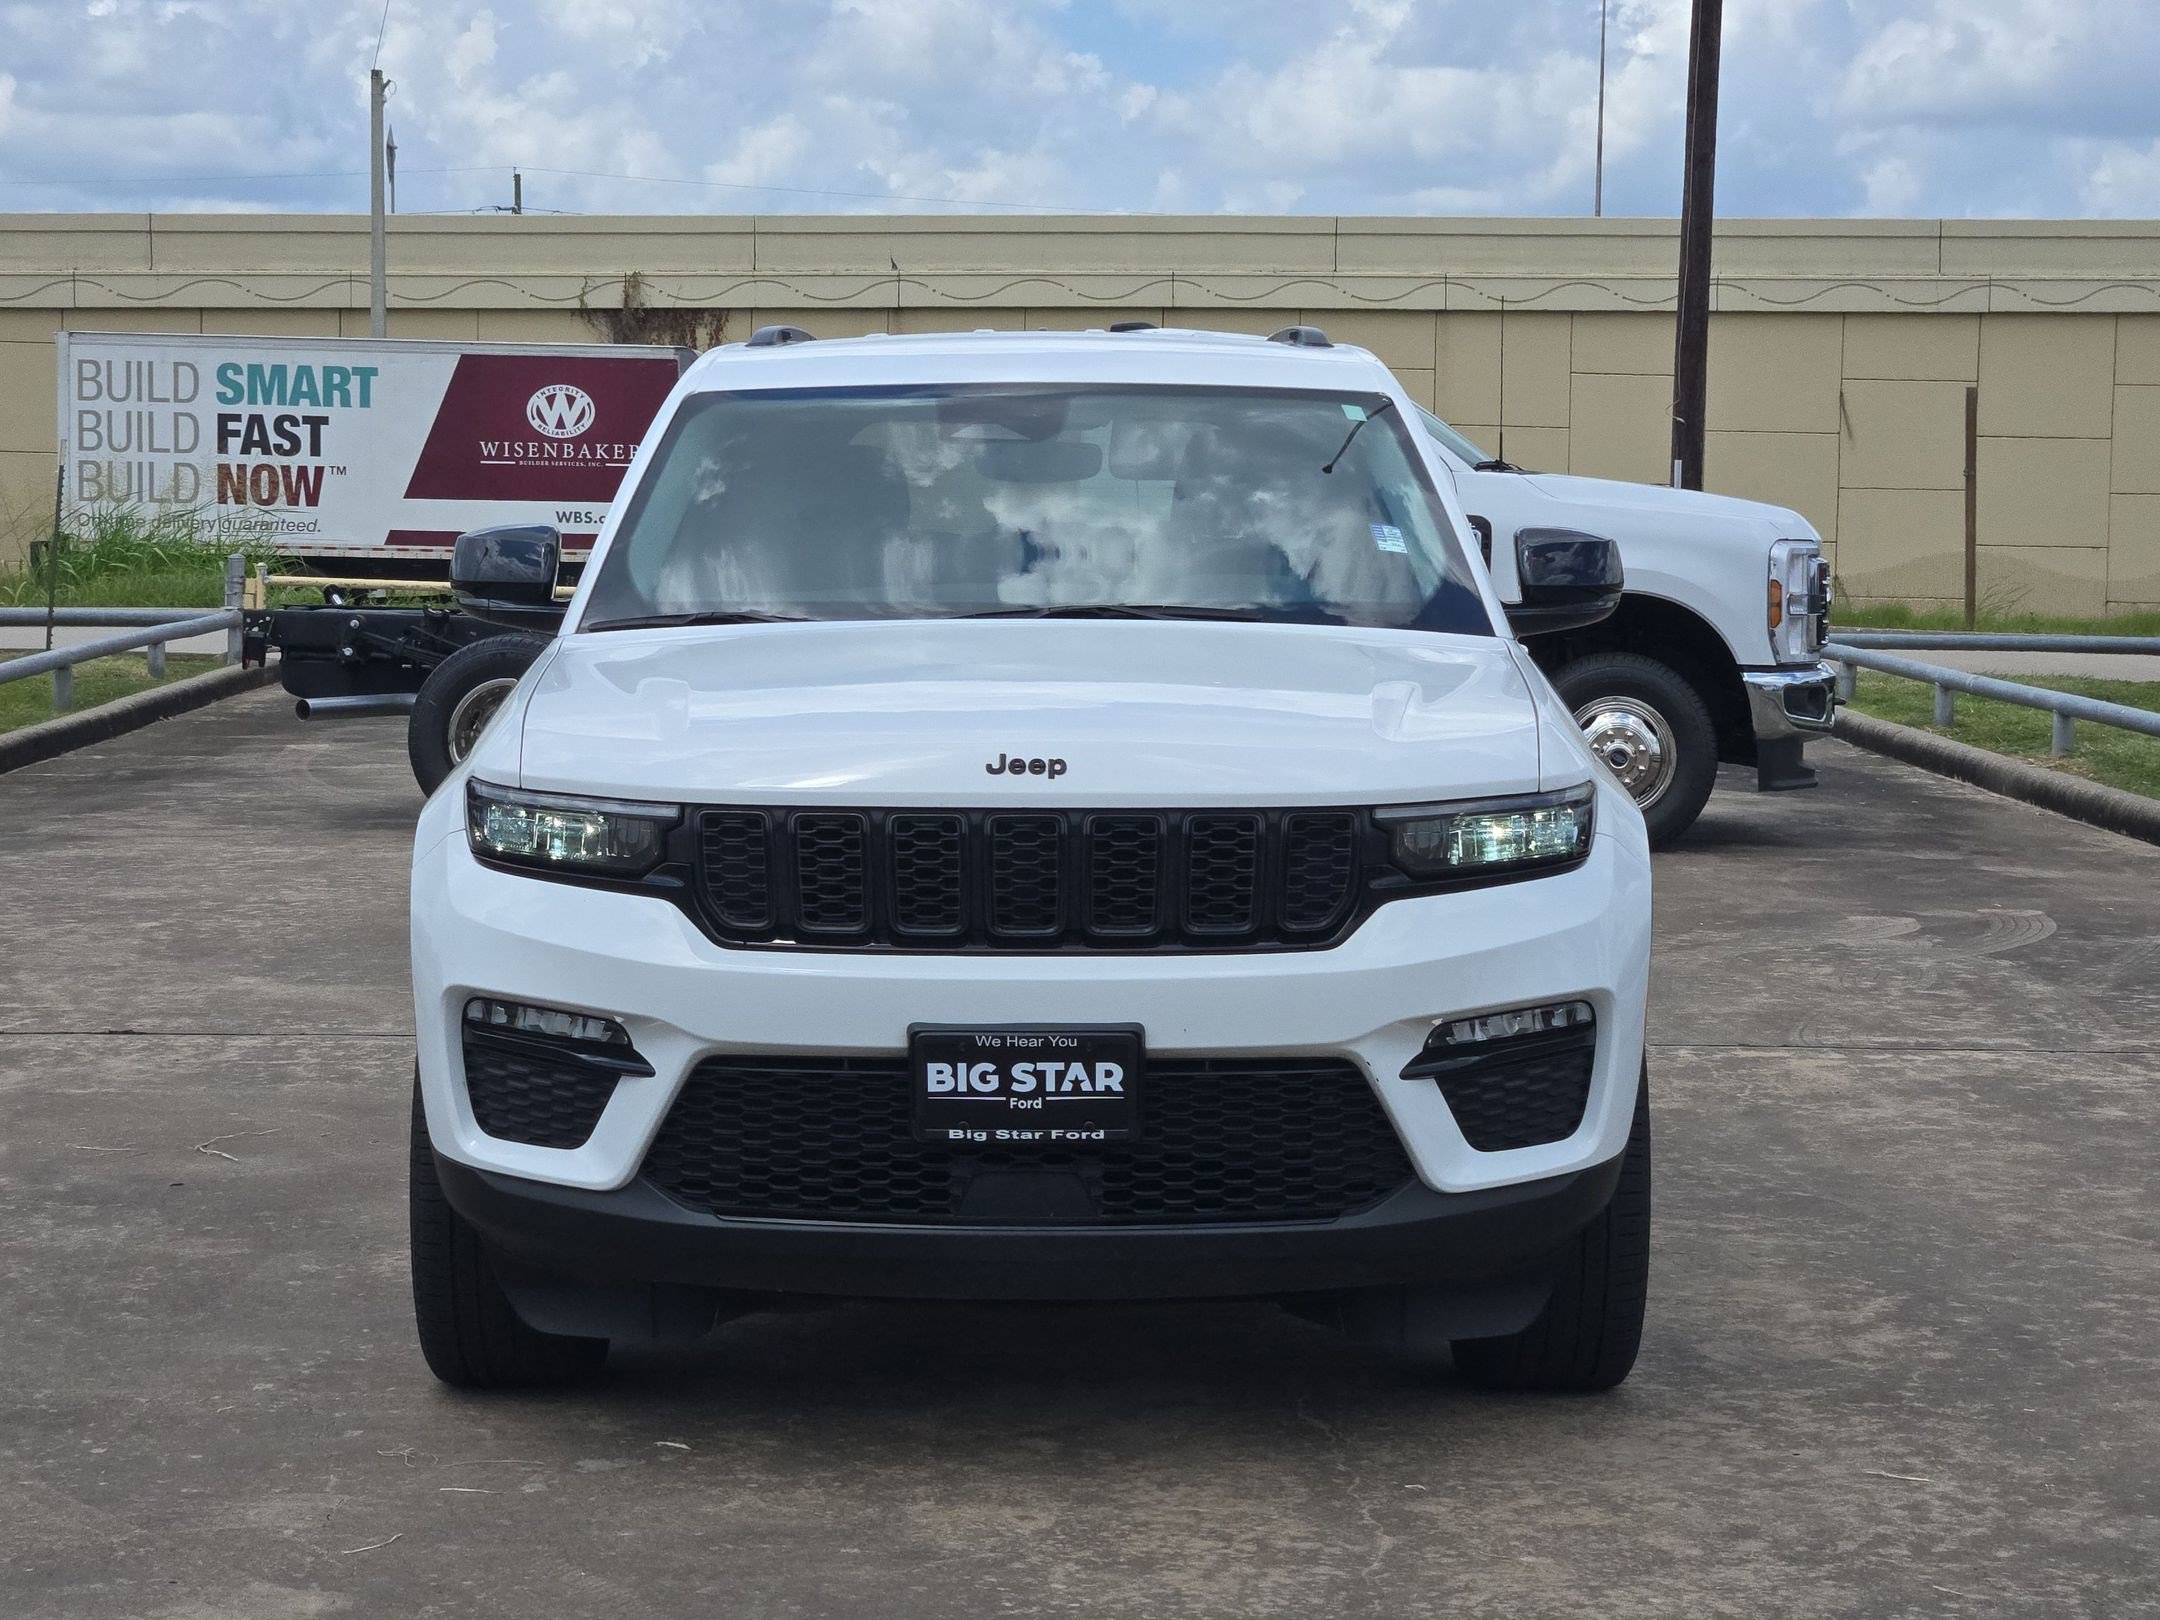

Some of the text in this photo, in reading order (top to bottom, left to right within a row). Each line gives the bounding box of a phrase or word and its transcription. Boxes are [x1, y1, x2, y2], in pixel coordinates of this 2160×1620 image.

[77, 359, 379, 409] BUILD SMART
[536, 386, 585, 399] INTEGRITY
[77, 409, 329, 457] BUILD FAST
[537, 423, 587, 437] RELIABILITY
[77, 459, 200, 504] BUILD
[217, 463, 325, 507] NOW
[220, 518, 321, 534] guaranteed.
[985, 753, 1068, 780] Jeep
[975, 1035, 1078, 1048] We Hear You
[926, 1062, 1124, 1093] BIG STAR
[1009, 1097, 1043, 1109] Ford
[948, 1129, 1105, 1142] Big Star Ford
